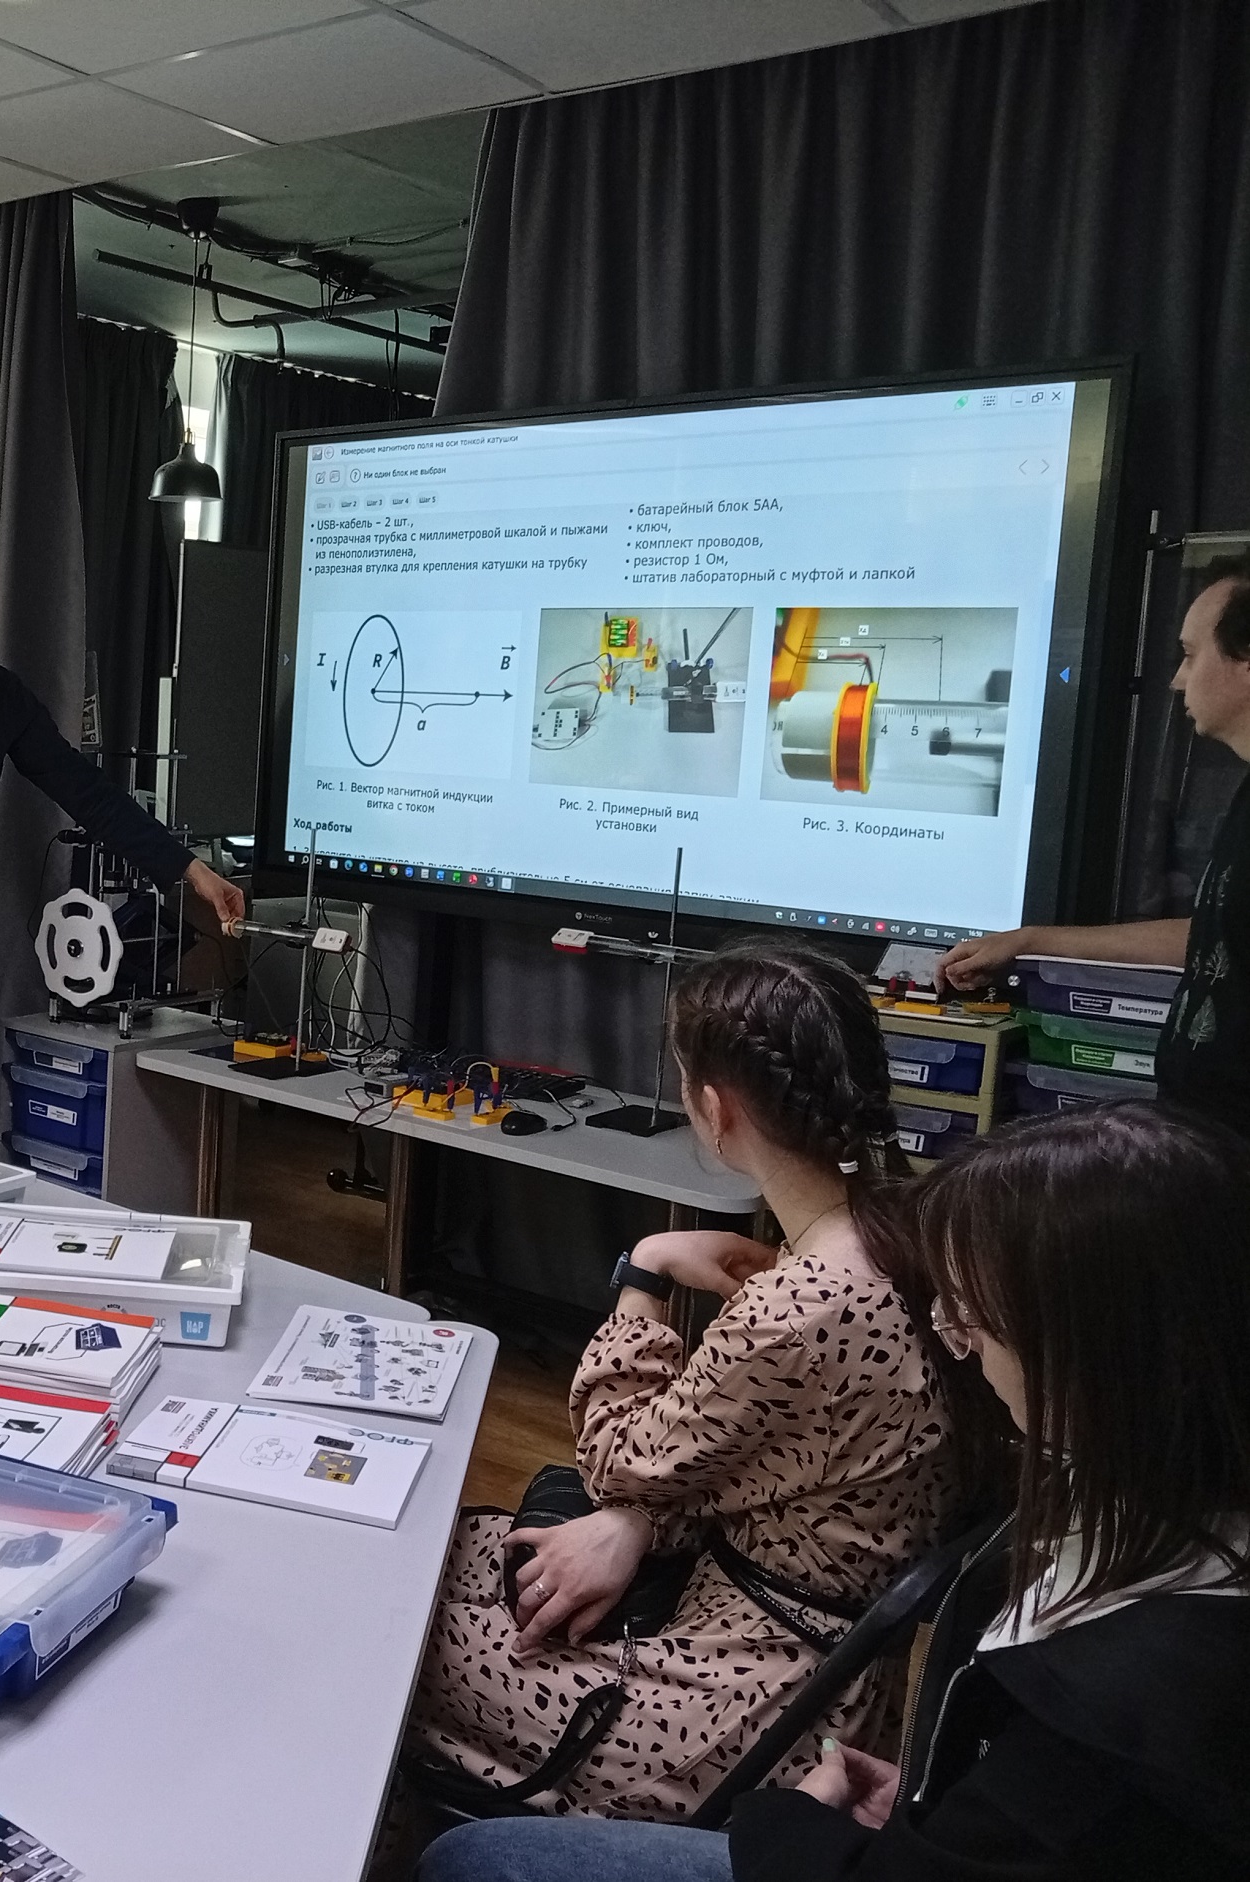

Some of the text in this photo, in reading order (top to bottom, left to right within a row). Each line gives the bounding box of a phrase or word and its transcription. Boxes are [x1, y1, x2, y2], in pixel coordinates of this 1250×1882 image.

[341, 447, 376, 456] Измерение
[378, 444, 415, 454] магнитного
[417, 442, 433, 450] поля
[446, 440, 458, 448] оси
[461, 437, 485, 446] тонкой
[487, 435, 519, 445] катушки
[364, 471, 373, 479] Ни
[374, 471, 391, 480] один
[392, 467, 408, 477] блок
[420, 466, 446, 476] выбран
[637, 500, 713, 517] батарейный
[718, 499, 748, 513] блок
[317, 518, 372, 531] USB-кабель
[385, 516, 391, 527] 2
[393, 517, 414, 529] шт.,
[636, 520, 672, 534] ключ,
[316, 524, 608, 546] прозрачная трубка с миллиметровой шкалой и пыжами
[635, 535, 764, 551] комплект проводов,
[315, 547, 417, 560] из пенополиэтилена,
[633, 552, 729, 569] резистор 1 Ом,
[314, 557, 588, 575] разрезная втулка для крепления катушки на трубку
[632, 565, 915, 585] штатив лабораторный с муфтой и лапкой
[372, 654, 383, 669] R
[881, 725, 888, 735] 4
[911, 726, 919, 736] 5
[975, 728, 982, 738] 7
[316, 779, 493, 804] Рис. 1. Вектор магнитной индукции
[366, 799, 435, 813] витка с током
[559, 798, 699, 822] Рис. 2. Примерный вид
[293, 818, 352, 834] Ход работы
[595, 819, 657, 833] установки
[802, 817, 945, 841] Рис. 3. Координаты
[943, 931, 956, 939] РУС
[1117, 1003, 1164, 1016] Температура
